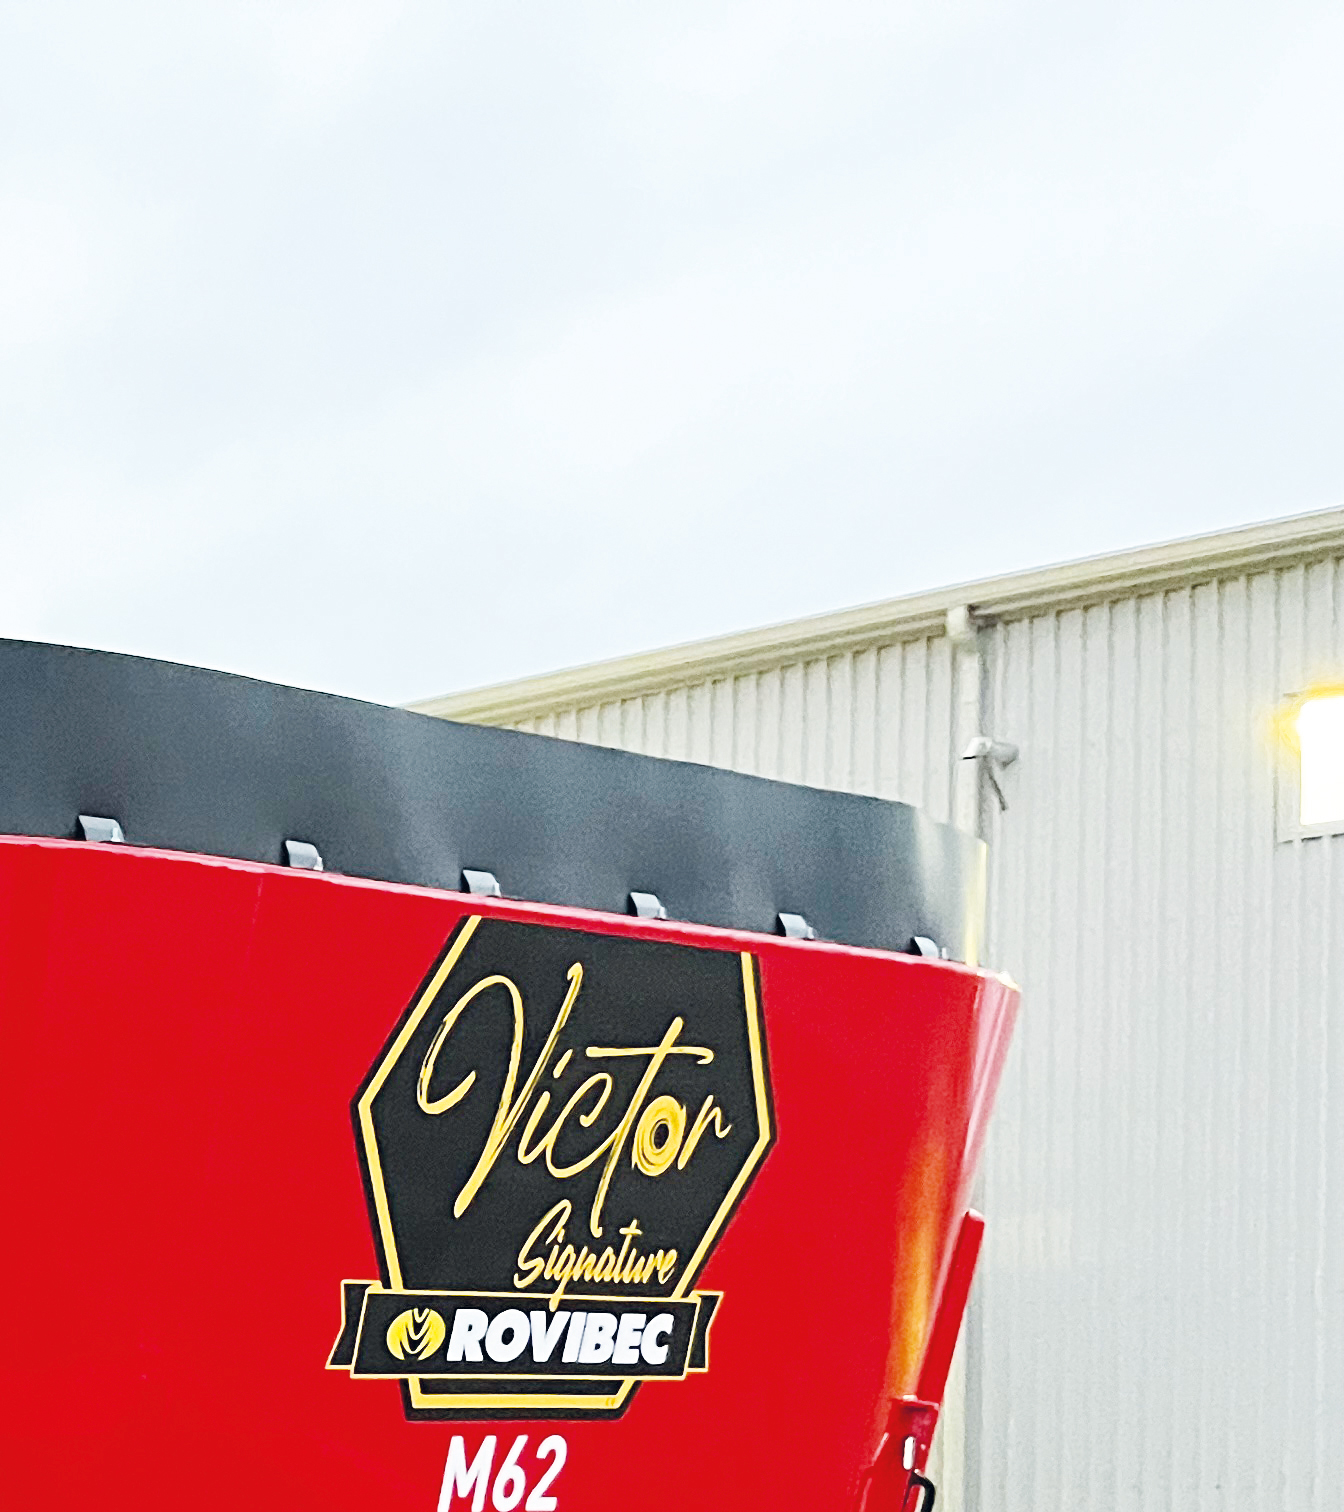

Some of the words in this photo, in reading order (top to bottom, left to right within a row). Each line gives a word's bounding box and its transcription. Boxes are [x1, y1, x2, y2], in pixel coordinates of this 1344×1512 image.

[417, 962, 731, 1237] Victor
[514, 1199, 676, 1309] Signature
[446, 1308, 674, 1364] ROVIBEC
